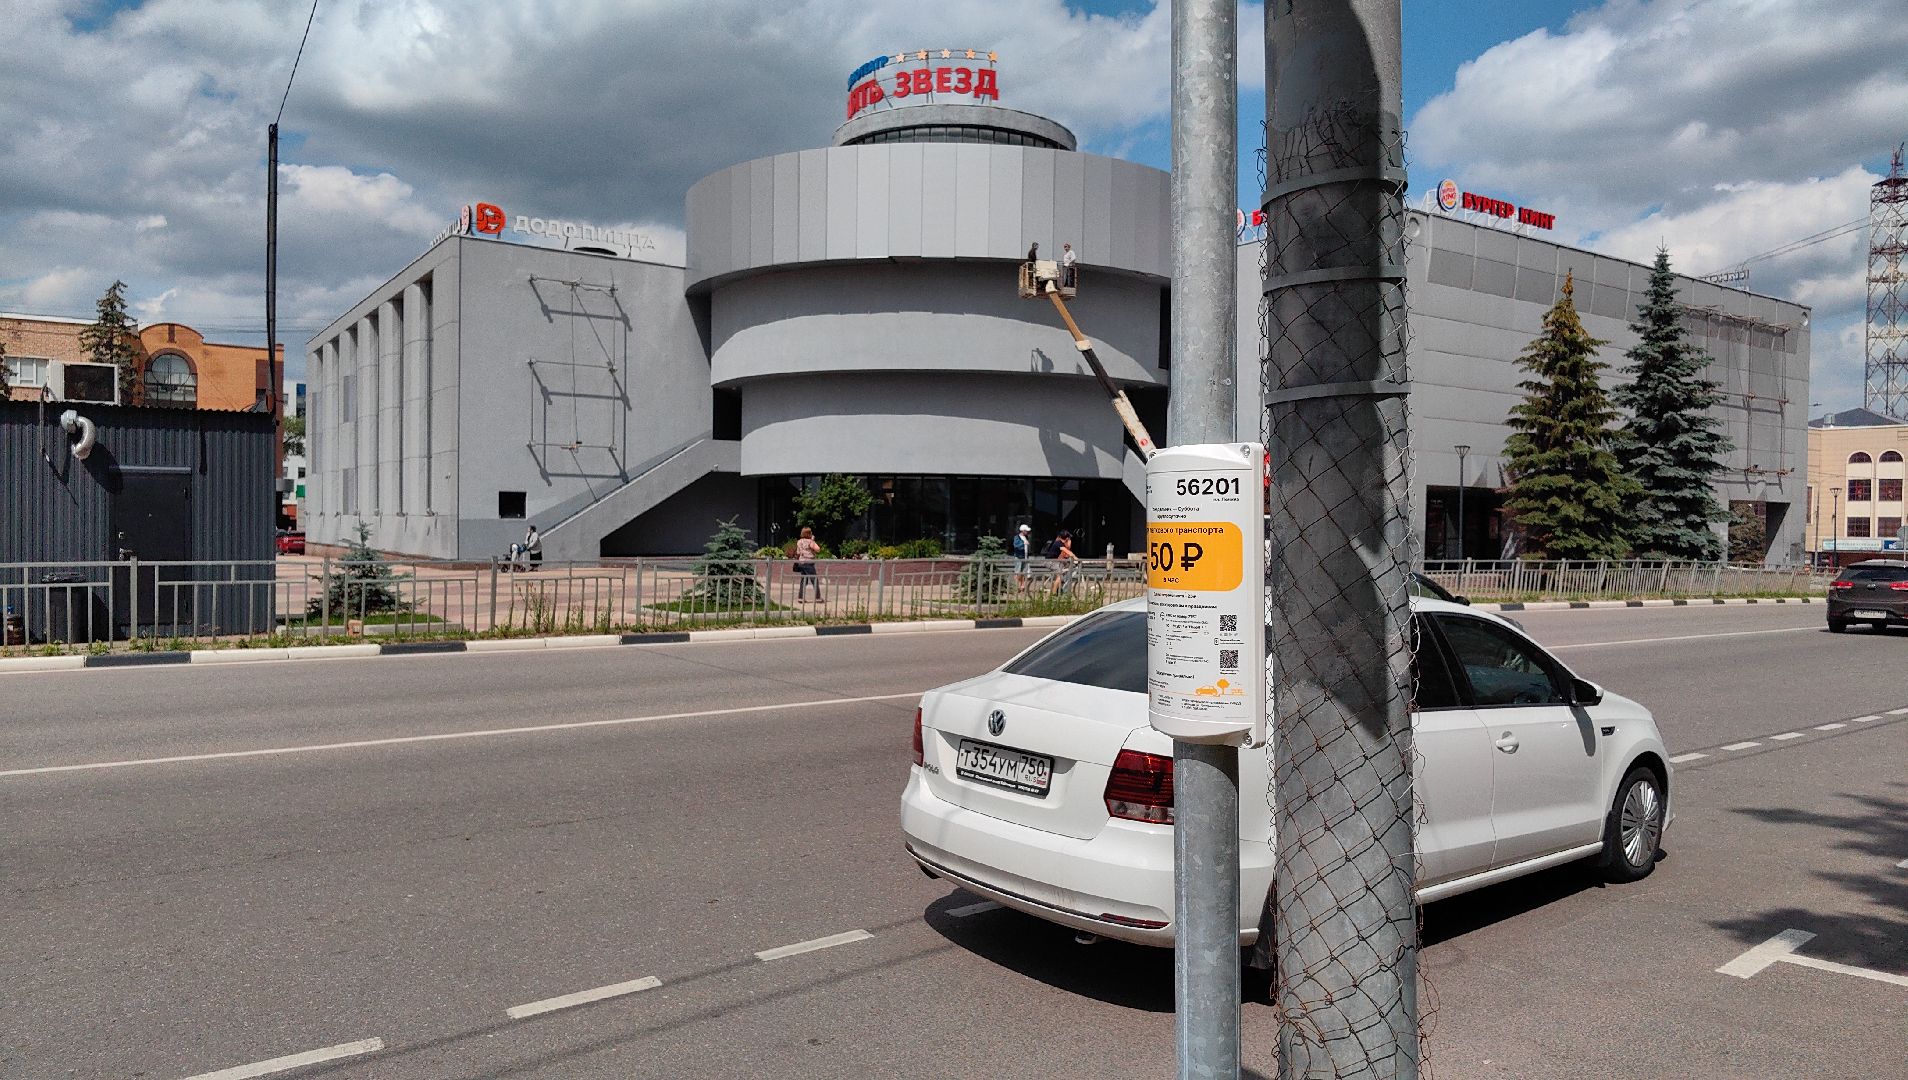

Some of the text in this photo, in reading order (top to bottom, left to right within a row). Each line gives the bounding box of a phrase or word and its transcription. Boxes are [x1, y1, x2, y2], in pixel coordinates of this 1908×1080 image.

[893, 67, 998, 100] ЗВЕЗД
[1462, 192, 1555, 230] БУРГЕР КИНГ
[1176, 478, 1240, 495] 56201
[1175, 527, 1224, 536] транспорта
[1150, 542, 1174, 572] 50
[1021, 755, 1046, 777] 750
